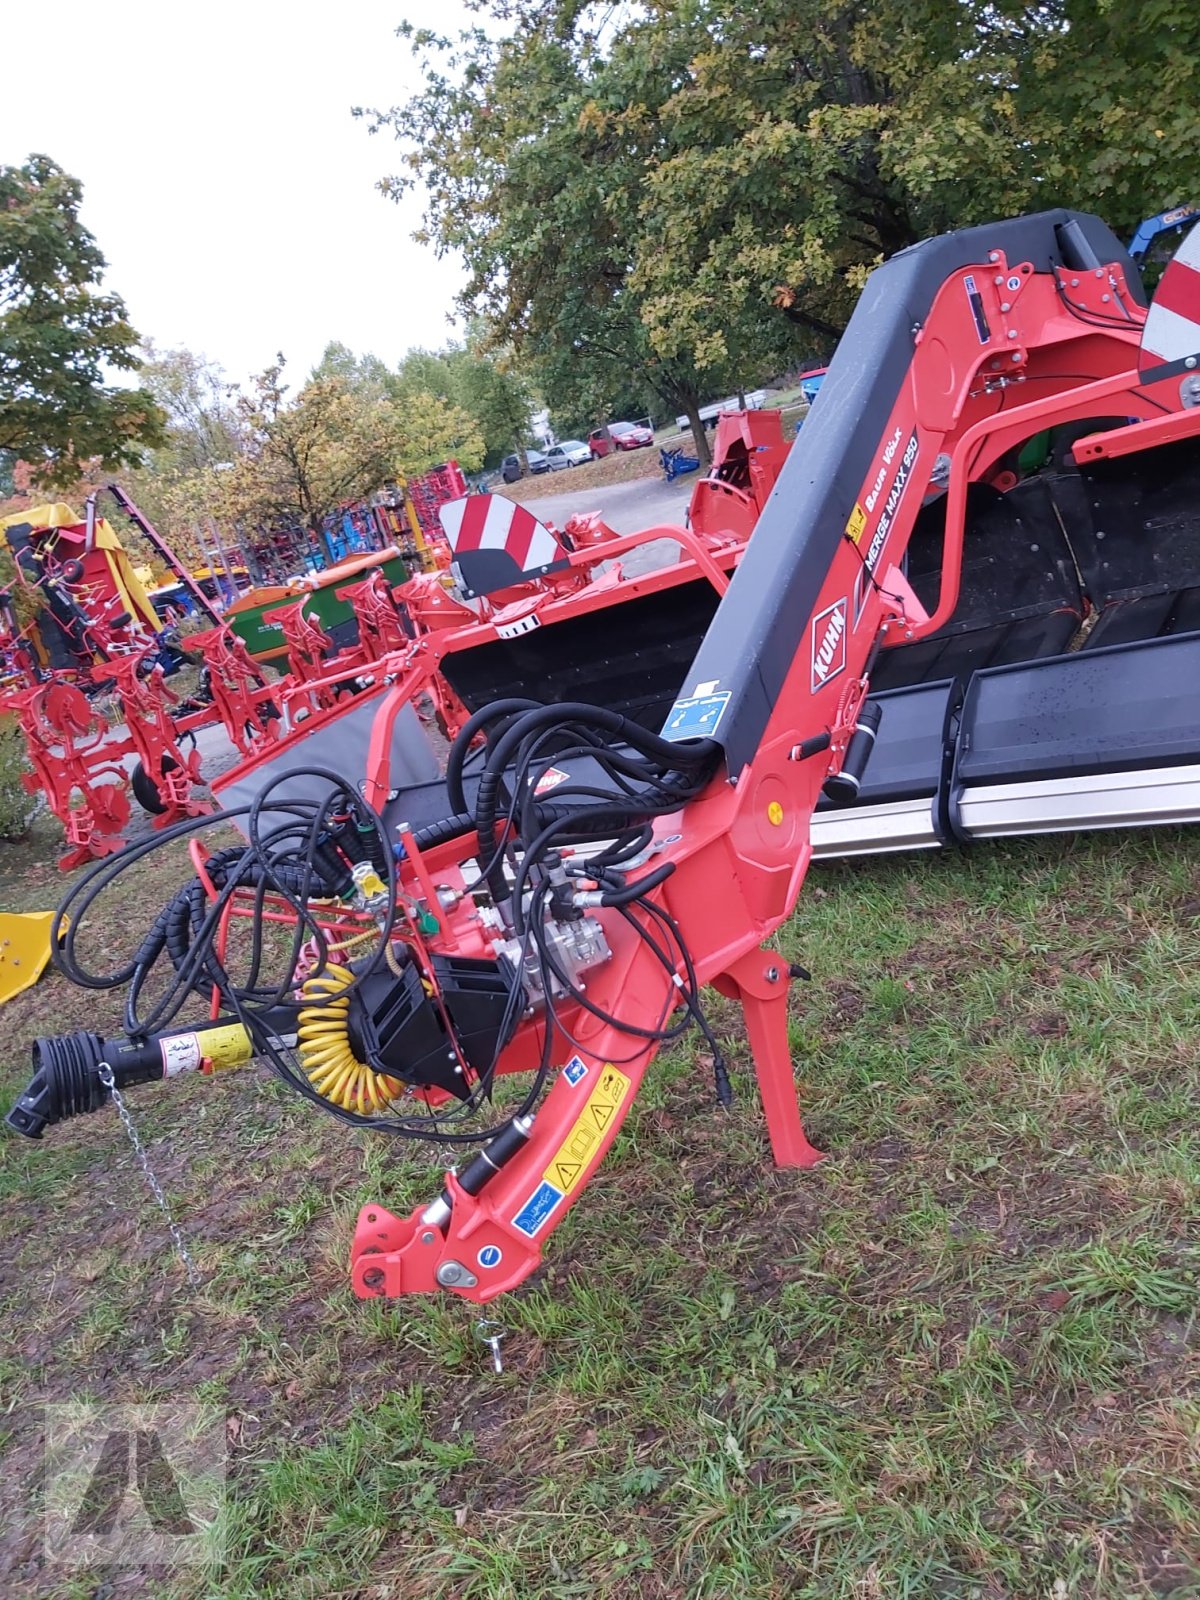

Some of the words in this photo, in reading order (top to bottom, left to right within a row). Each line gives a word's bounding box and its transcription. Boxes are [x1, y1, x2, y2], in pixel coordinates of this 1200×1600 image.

[865, 513, 889, 571] MERGE
[886, 466, 907, 515] MAXX
[903, 436, 918, 467] 950
[813, 606, 845, 680] KUHN
